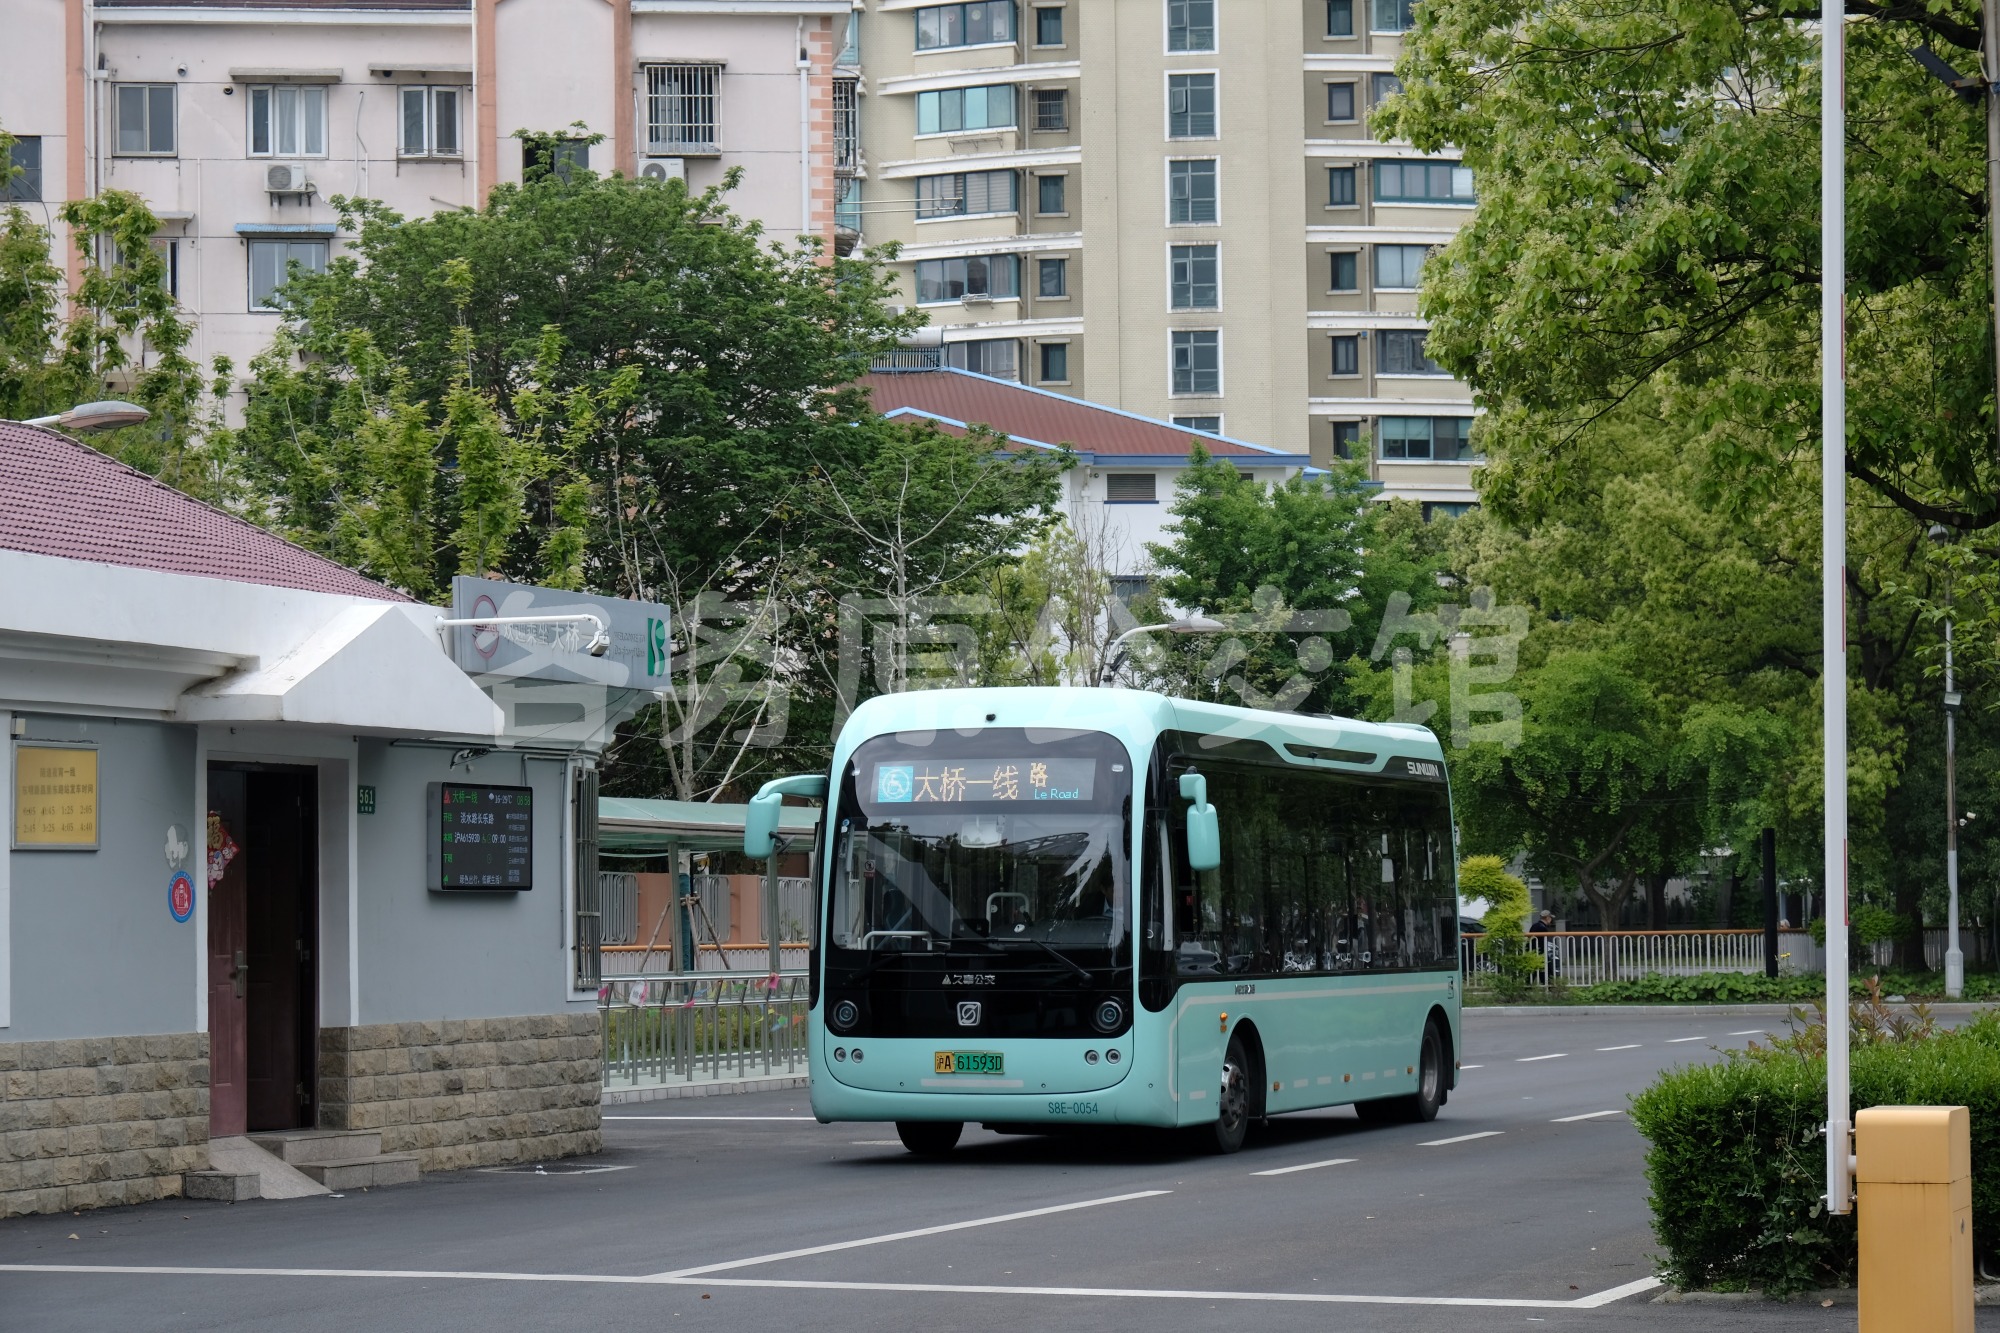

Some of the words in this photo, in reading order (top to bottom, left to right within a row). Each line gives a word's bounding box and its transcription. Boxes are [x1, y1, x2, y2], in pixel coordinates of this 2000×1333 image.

[1407, 761, 1439, 777] SUNWIN
[914, 765, 1019, 801] 大桥一线
[1030, 763, 1048, 788] 路
[360, 789, 374, 804] 561
[452, 790, 479, 804] 大桥一线
[1034, 788, 1048, 800] Le
[1051, 788, 1079, 799] Road
[491, 834, 507, 844] 09:00
[1048, 1101, 1098, 1115] S8E-0054
